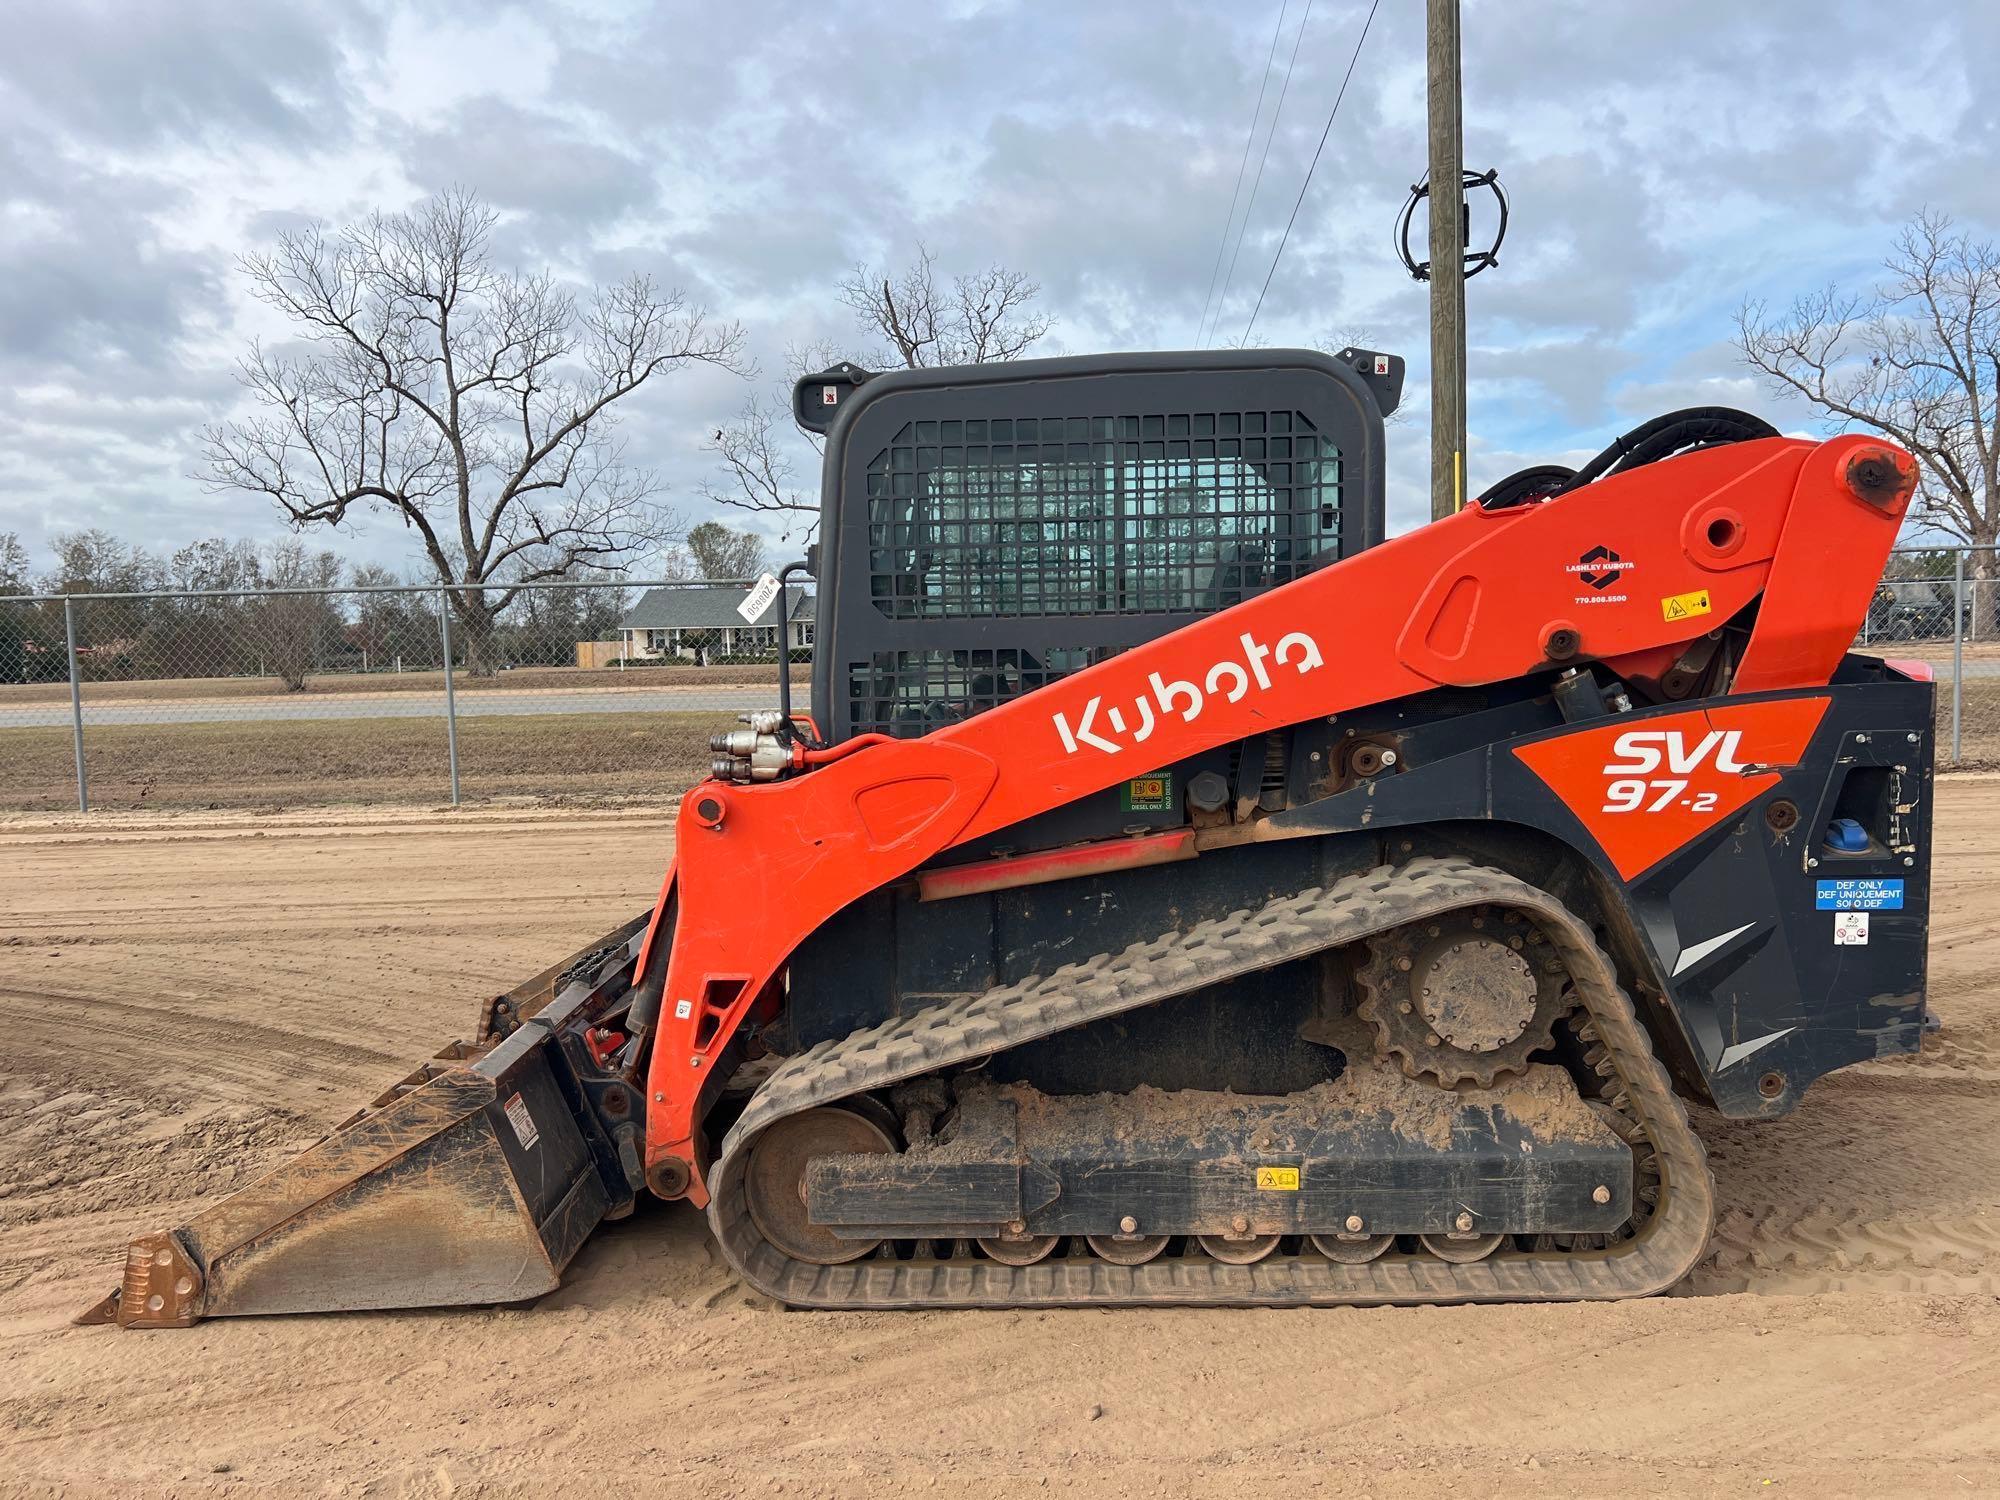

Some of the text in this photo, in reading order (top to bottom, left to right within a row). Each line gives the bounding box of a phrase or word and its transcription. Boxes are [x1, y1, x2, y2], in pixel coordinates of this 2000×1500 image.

[1566, 562, 1634, 572] LASHLEY KUBOTA
[1052, 632, 1325, 754] Kubota
[1602, 730, 1767, 774] SVL
[1601, 779, 1718, 813] 97-2
[1836, 881, 1884, 890] DEF ONLY
[1818, 890, 1901, 899] DEF UNIQUEMENT
[1864, 899, 1883, 908] DEF
